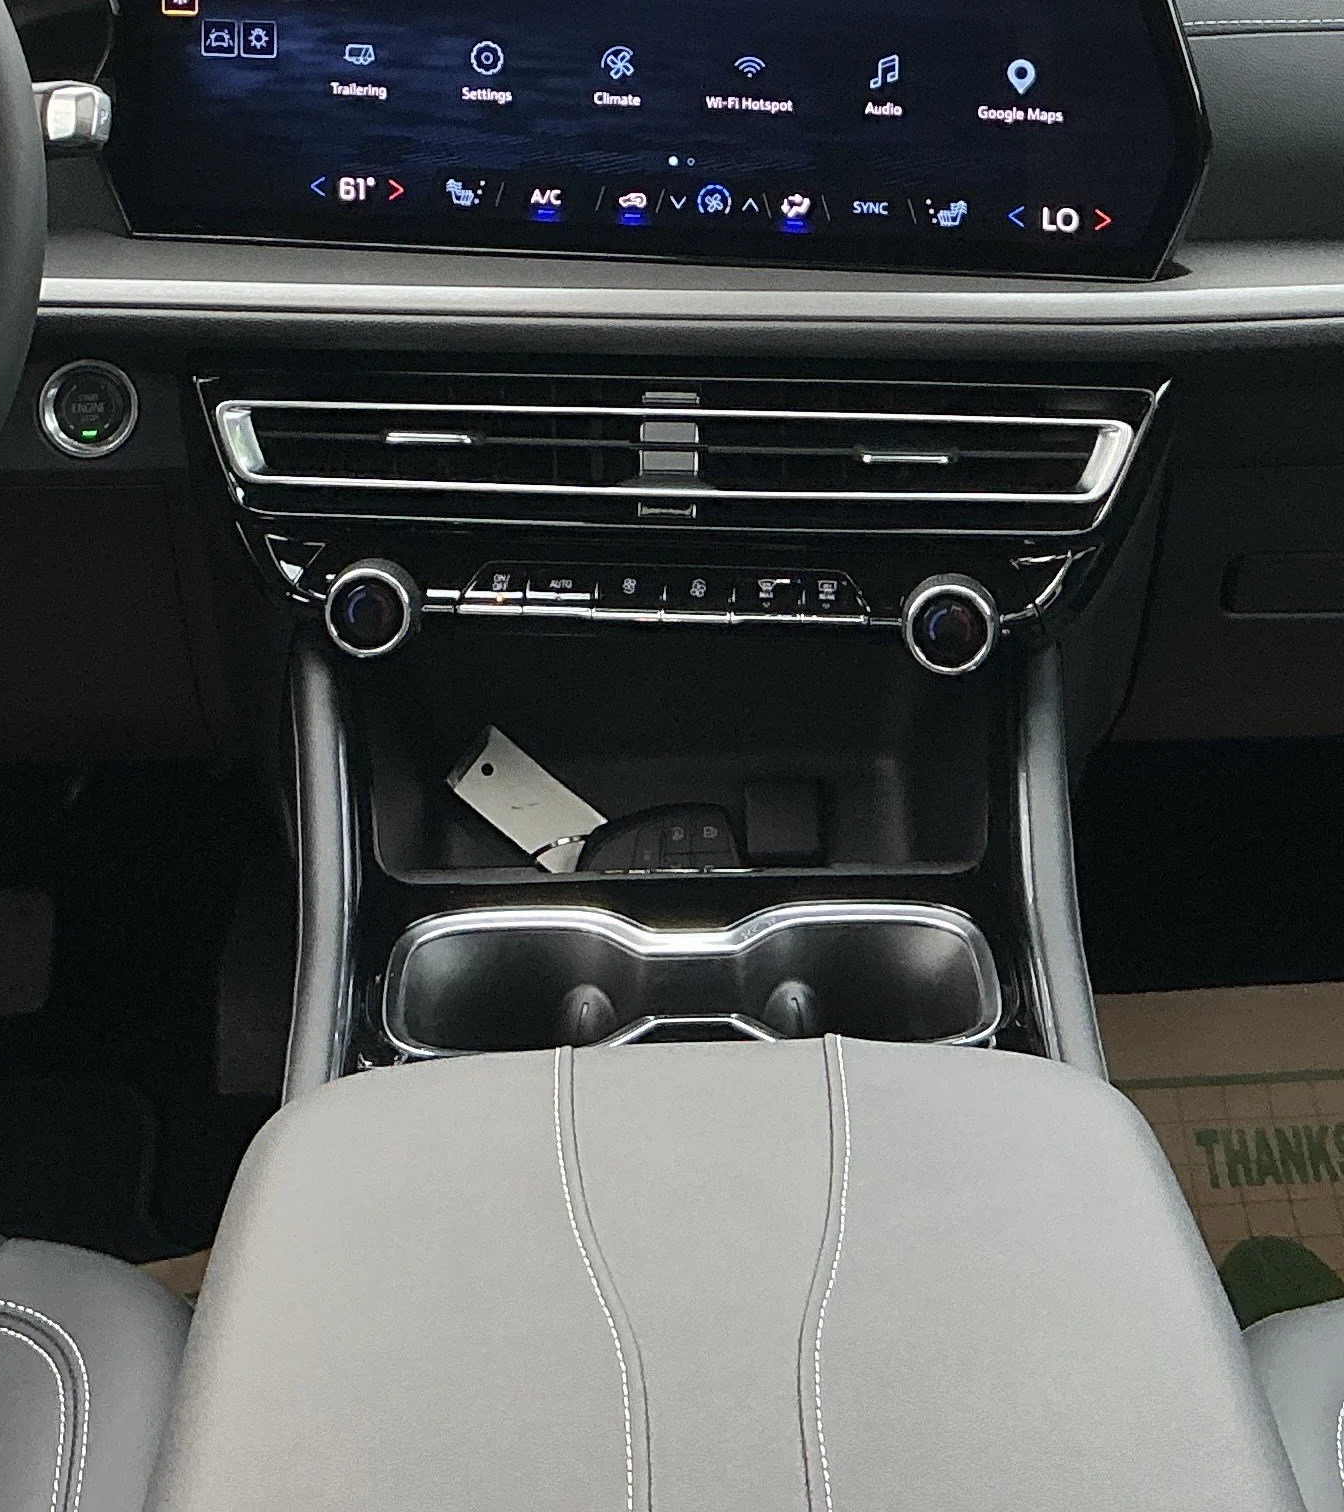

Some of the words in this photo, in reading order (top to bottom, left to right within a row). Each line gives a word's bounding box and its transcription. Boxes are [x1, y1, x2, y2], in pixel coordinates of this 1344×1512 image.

[330, 82, 387, 101] Trailering
[461, 87, 513, 105] Settings
[593, 91, 642, 108] Climate
[705, 96, 739, 112] Wi-Fi
[741, 97, 794, 116] Hotspot
[864, 101, 904, 118] Audio
[977, 105, 1024, 124] Google
[1026, 107, 1064, 125] Maps
[530, 188, 562, 206] A/C
[852, 200, 889, 216] SYNC
[1042, 207, 1080, 233] LO
[549, 579, 573, 589] AUTO
